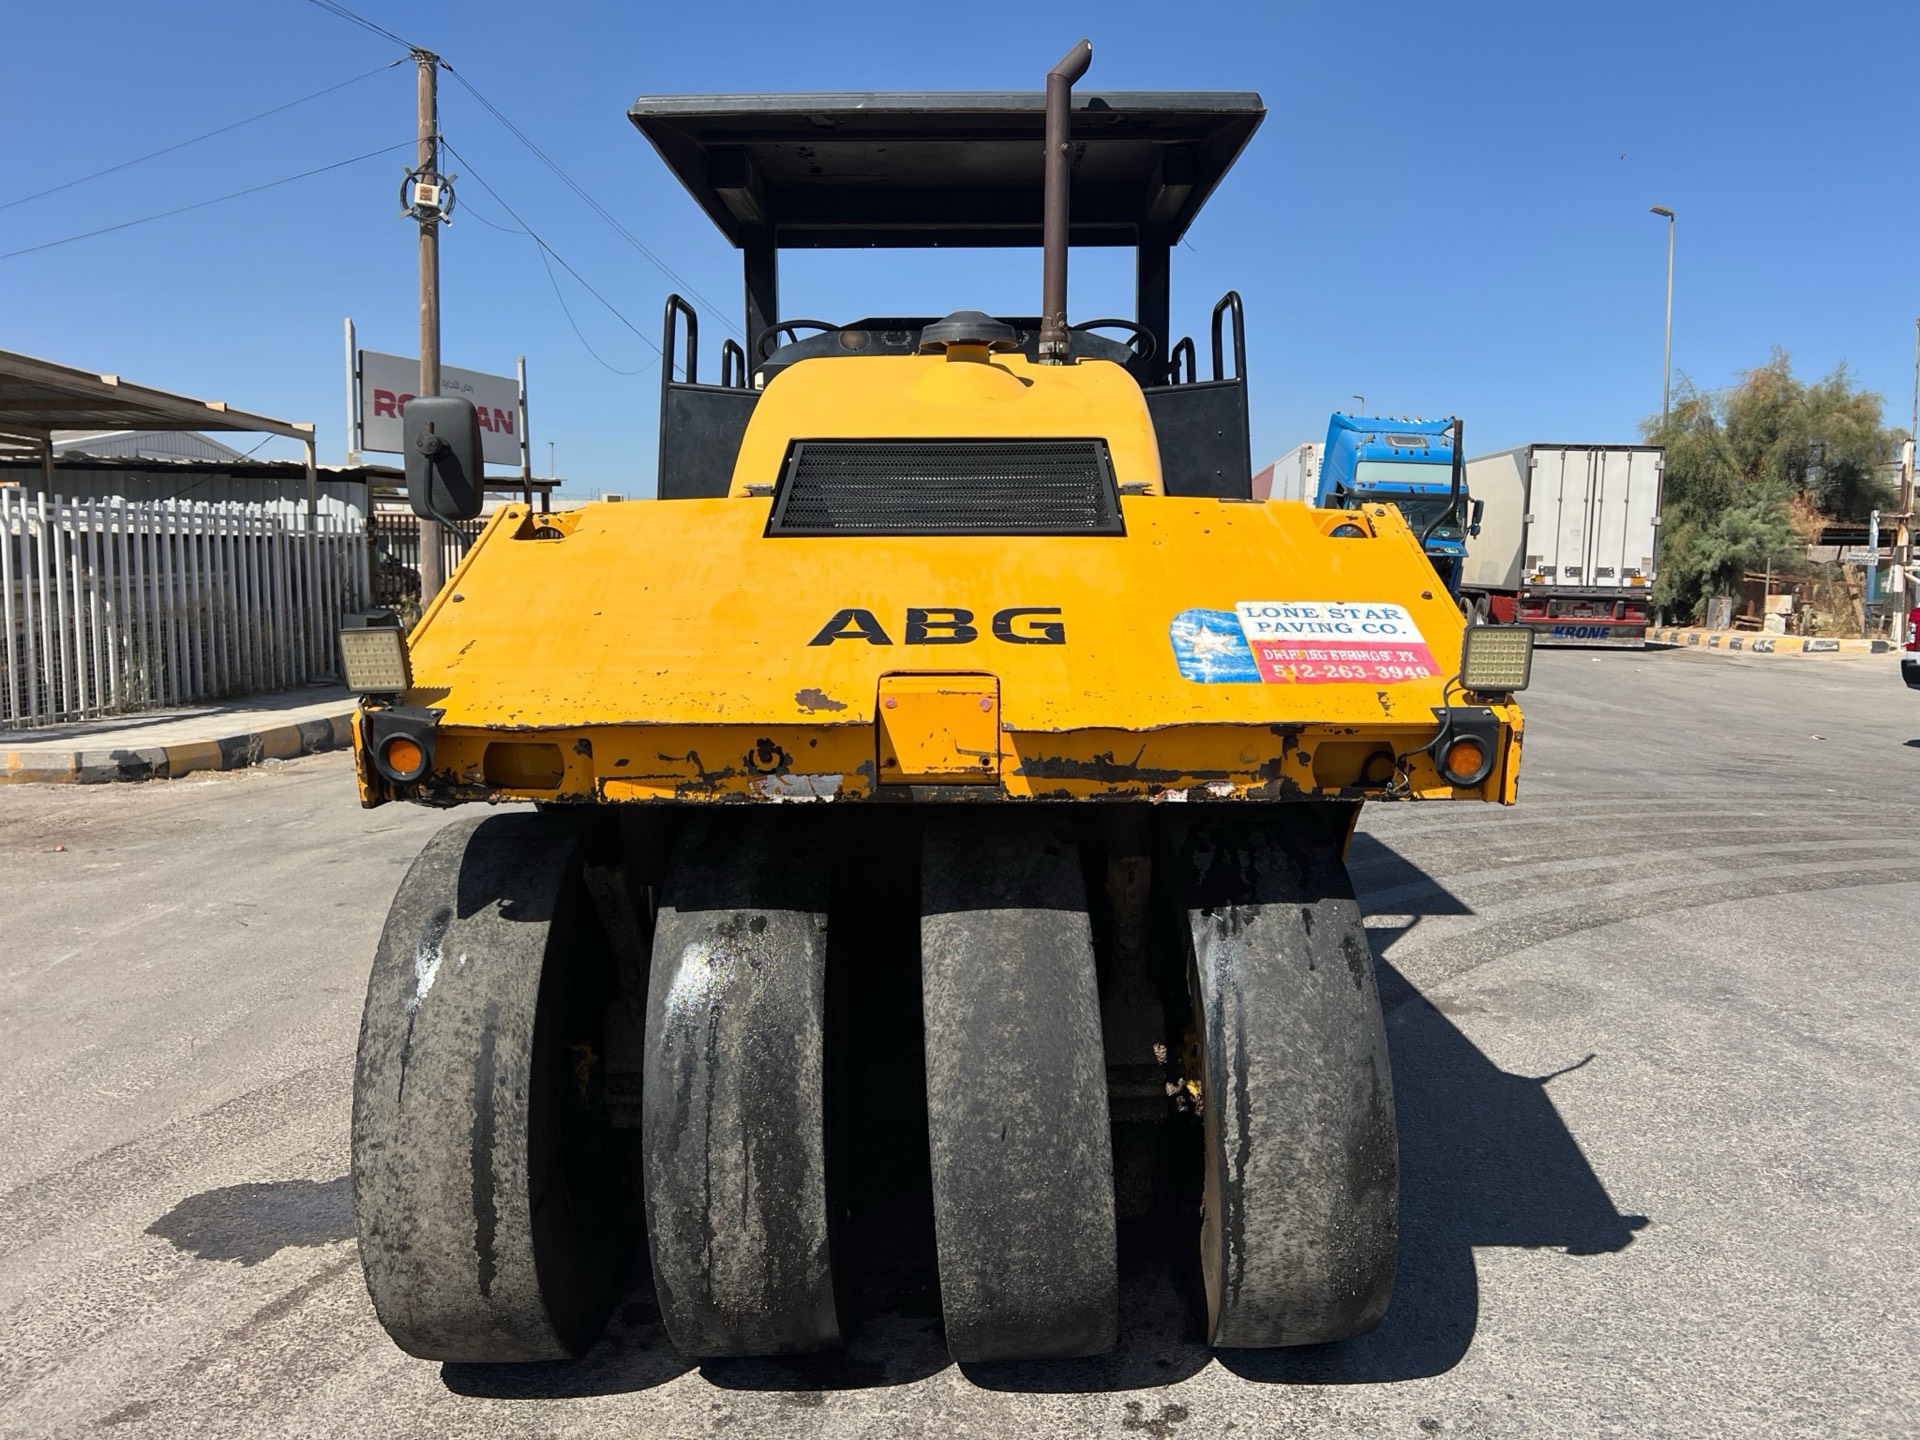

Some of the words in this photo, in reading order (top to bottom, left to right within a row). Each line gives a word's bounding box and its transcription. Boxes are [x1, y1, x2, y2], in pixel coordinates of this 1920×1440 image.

[374, 389, 514, 435] ROAN
[1245, 606, 1320, 619] LONE
[1328, 607, 1403, 621] STAR
[807, 607, 1067, 647] ABG
[1257, 622, 1353, 634] PAVING
[1361, 623, 1408, 635] CO.
[1551, 625, 1611, 640] KRONE
[1273, 663, 1432, 680] 512-263-3949
